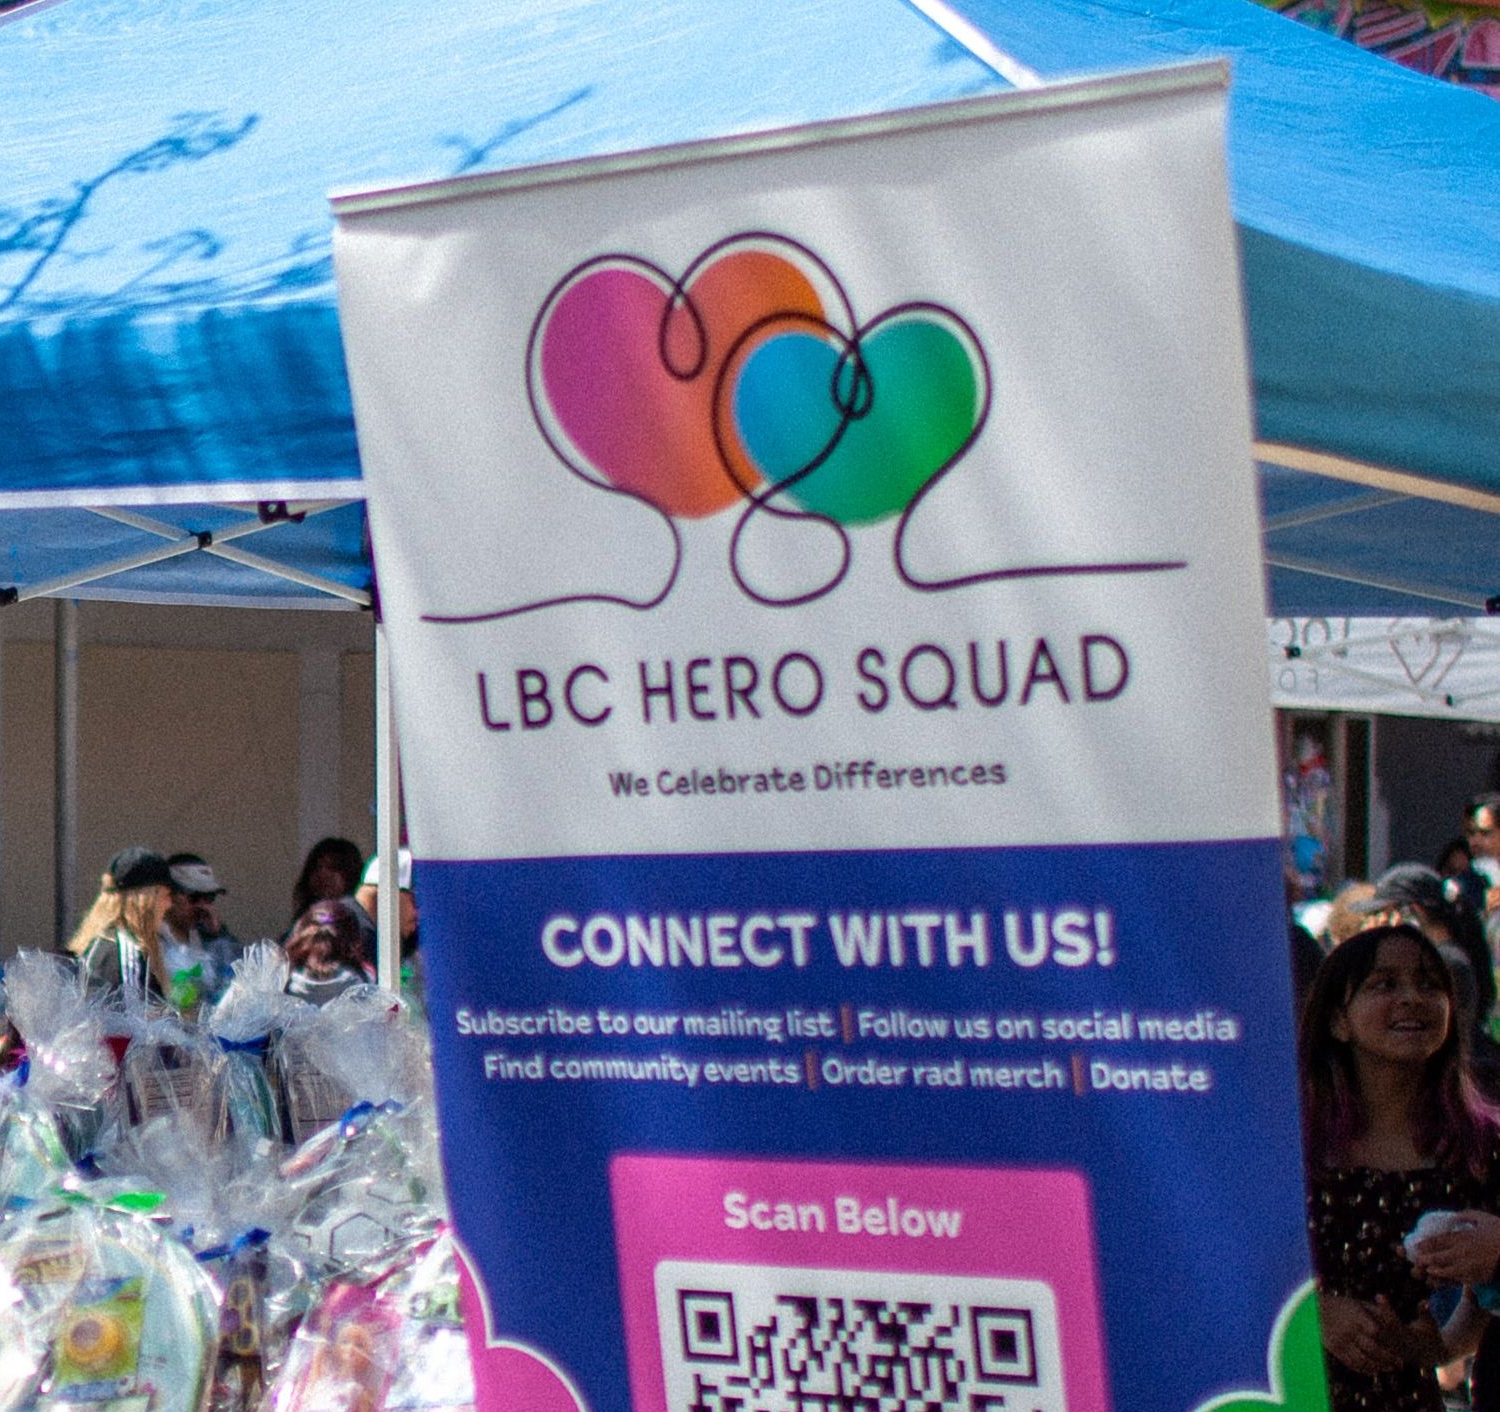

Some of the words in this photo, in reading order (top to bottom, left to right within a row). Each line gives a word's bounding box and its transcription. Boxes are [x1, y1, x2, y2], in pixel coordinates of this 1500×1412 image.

[477, 663, 613, 731] LBC
[639, 651, 824, 724] HERO
[855, 634, 1130, 713] SQUAD
[608, 771, 651, 797] We
[656, 767, 806, 796] Celebrate
[813, 760, 1008, 792] Differences
[541, 914, 816, 970] CONNECT
[829, 912, 989, 969] WITH
[1005, 910, 1117, 968] US!
[456, 1008, 592, 1036] Subscribe
[597, 1010, 628, 1036] to
[632, 1017, 676, 1036] our
[683, 1010, 784, 1043] mailing
[787, 1010, 836, 1038] list
[857, 1011, 949, 1040] Follow
[953, 1018, 990, 1040] us
[996, 1018, 1035, 1040] on
[1041, 1011, 1130, 1042] social
[1137, 1011, 1238, 1043] media
[483, 1054, 544, 1080] Find
[549, 1055, 698, 1088] community
[703, 1058, 798, 1084] events
[821, 1058, 907, 1086] Order
[912, 1061, 964, 1087] rad
[969, 1061, 1064, 1089] merch
[1090, 1062, 1211, 1091] Donate
[722, 1191, 826, 1233] Scan
[834, 1196, 963, 1238] Below
